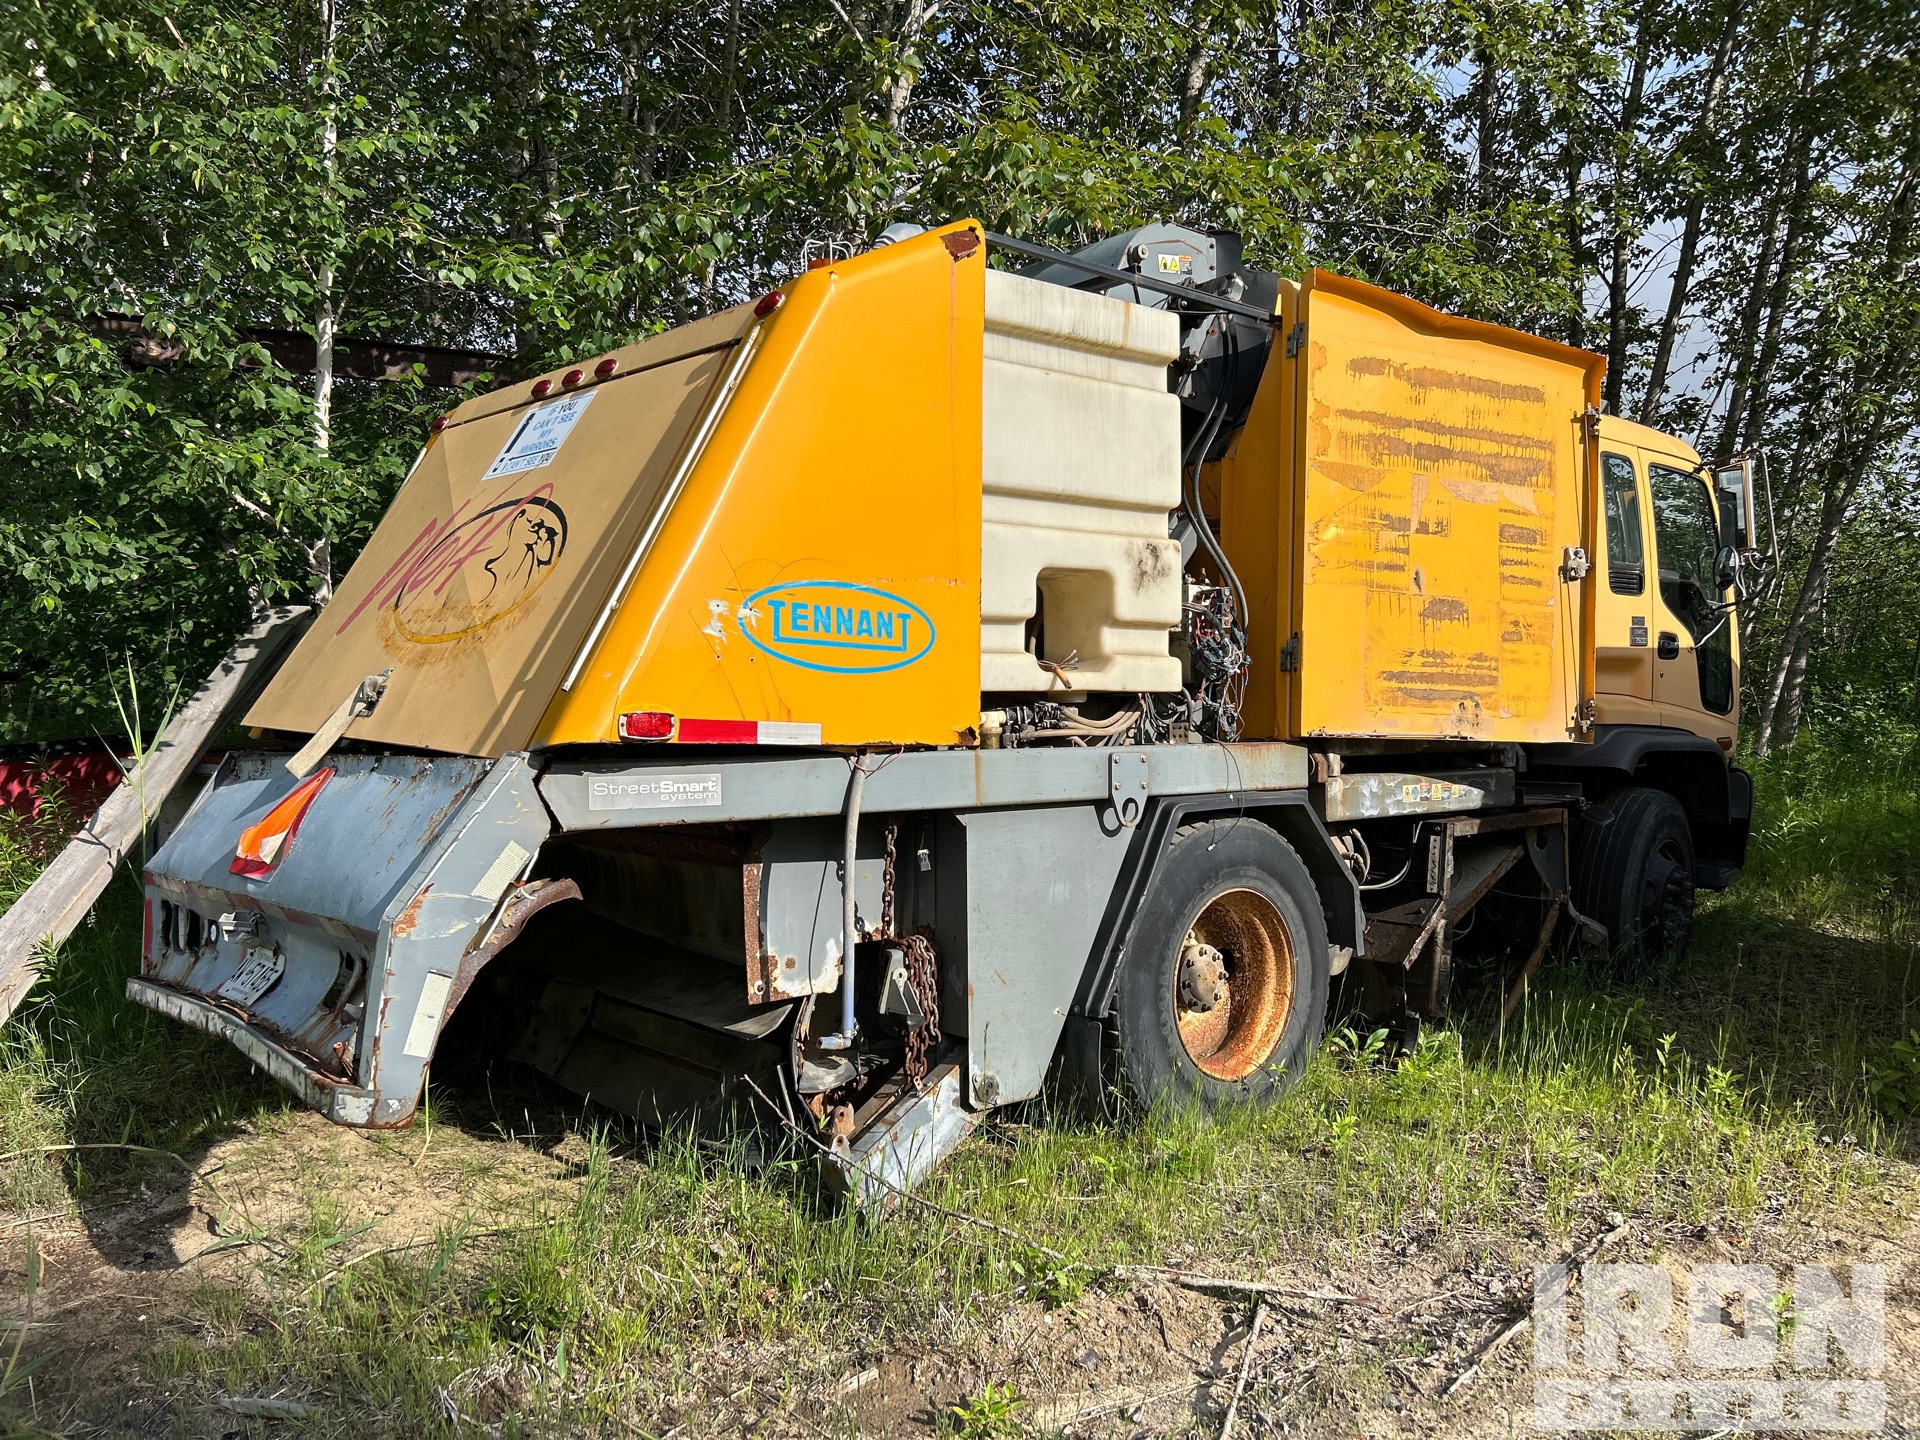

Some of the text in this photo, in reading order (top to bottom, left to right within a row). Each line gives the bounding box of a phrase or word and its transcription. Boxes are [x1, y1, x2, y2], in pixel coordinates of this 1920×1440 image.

[547, 401, 579, 417] IF YOU
[533, 411, 578, 431] CAN'T SEE
[537, 428, 554, 440] MY
[518, 437, 558, 455] MIRRORS
[524, 455, 540, 467] SEE
[538, 451, 556, 464] YOU
[767, 598, 912, 652] TENNANT
[594, 780, 717, 796] StreetSmart
[660, 791, 717, 802] system
